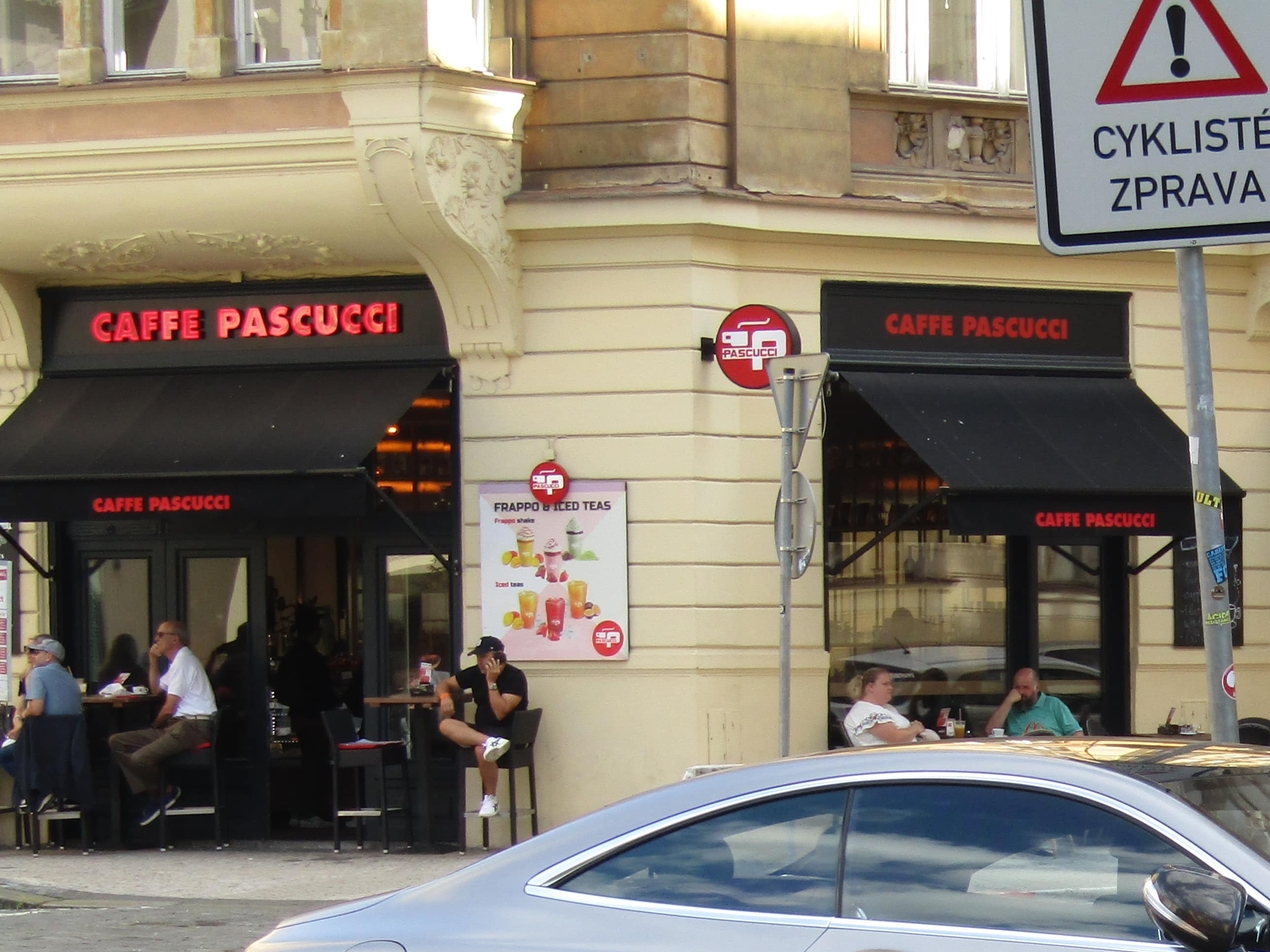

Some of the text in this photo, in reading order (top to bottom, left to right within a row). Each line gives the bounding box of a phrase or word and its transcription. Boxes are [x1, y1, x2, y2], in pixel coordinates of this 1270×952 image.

[1110, 169, 1267, 212] ZPRAVA
[92, 302, 400, 343] CAFFE PASCUCCI
[885, 313, 1069, 340] CAFFE PASCUCCI
[723, 348, 778, 358] PASCUCCI
[92, 495, 231, 513] CAFFE PASCUCCI
[494, 502, 540, 512] FRAPPO
[553, 501, 580, 511] ICED
[583, 501, 612, 511] TEAS
[1035, 512, 1156, 528] CAFFE PASCUCCI
